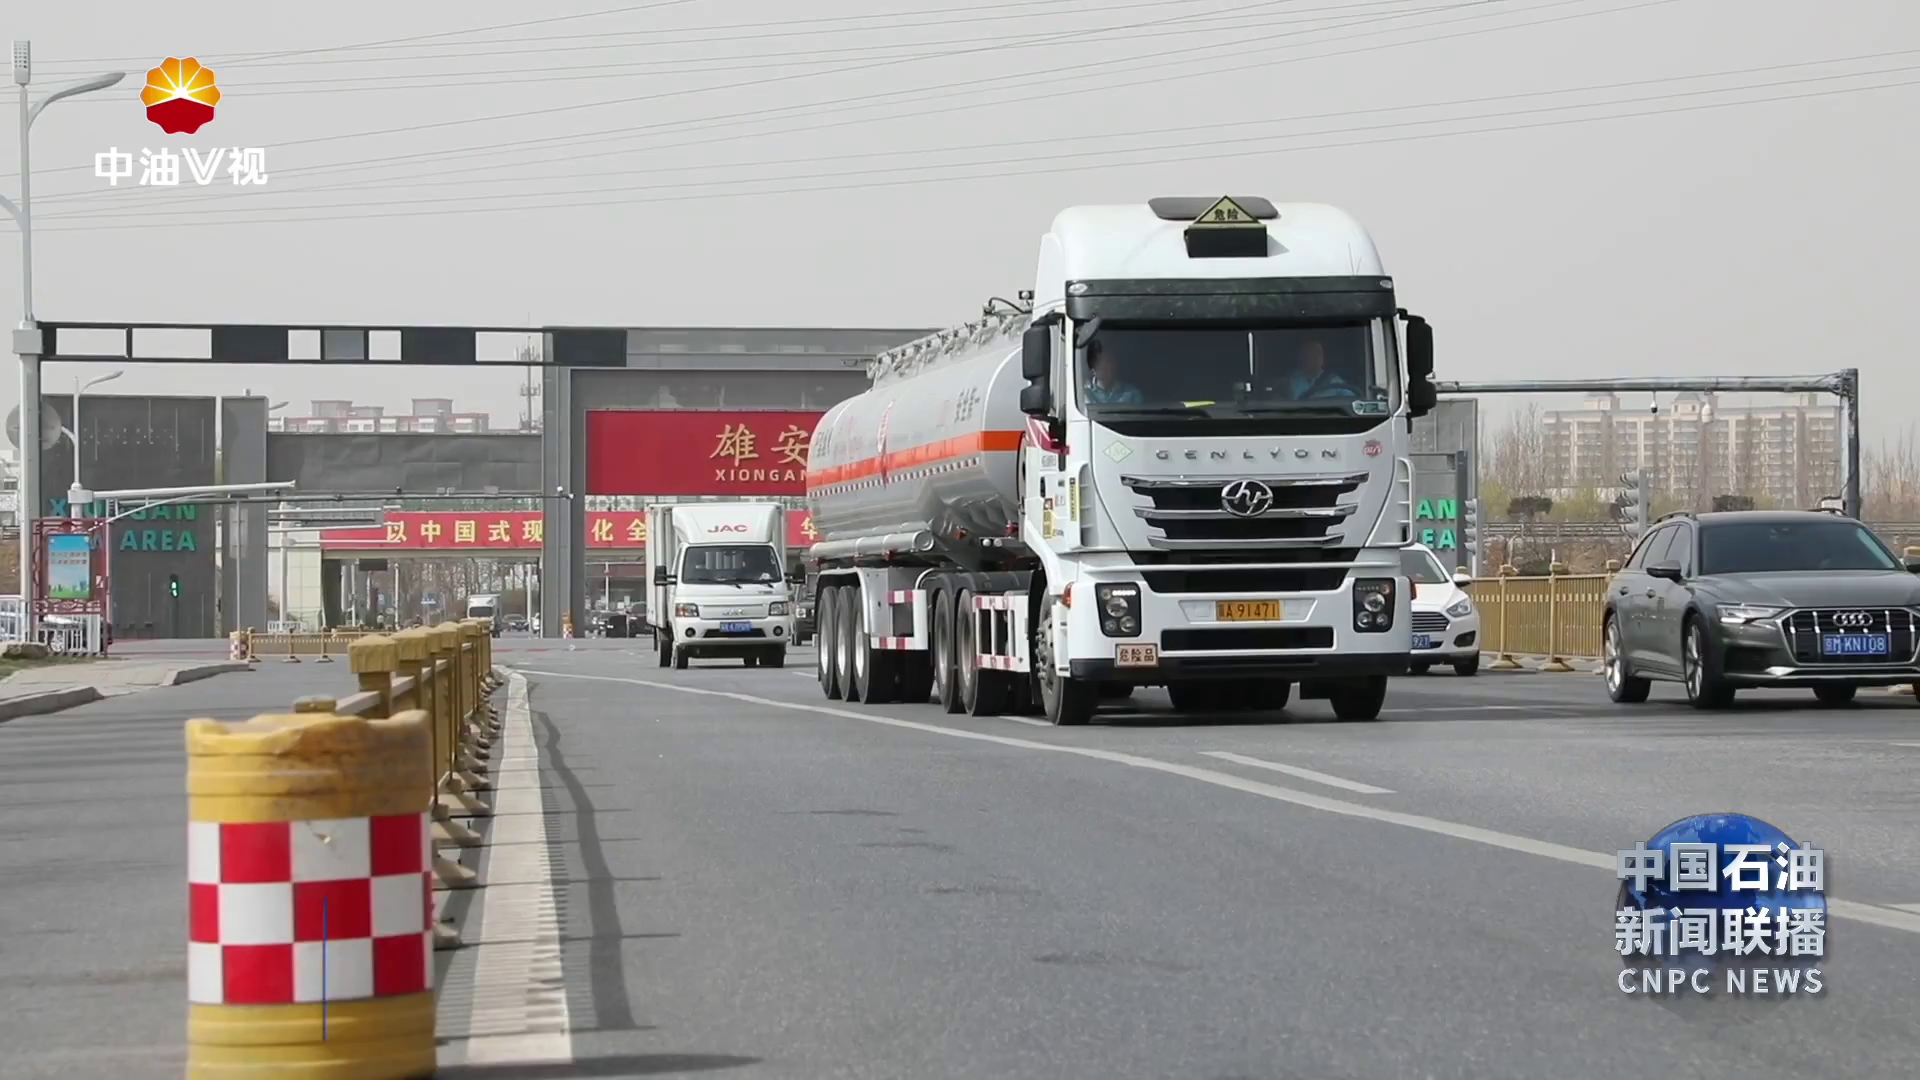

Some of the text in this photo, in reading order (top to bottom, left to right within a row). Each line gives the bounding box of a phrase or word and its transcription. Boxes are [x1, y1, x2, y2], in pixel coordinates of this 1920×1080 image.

[1214, 208, 1239, 221] 危险
[709, 423, 809, 467] 雄安
[1156, 447, 1338, 461] GENLYON
[707, 524, 748, 533] JAC
[119, 529, 197, 551] AREA
